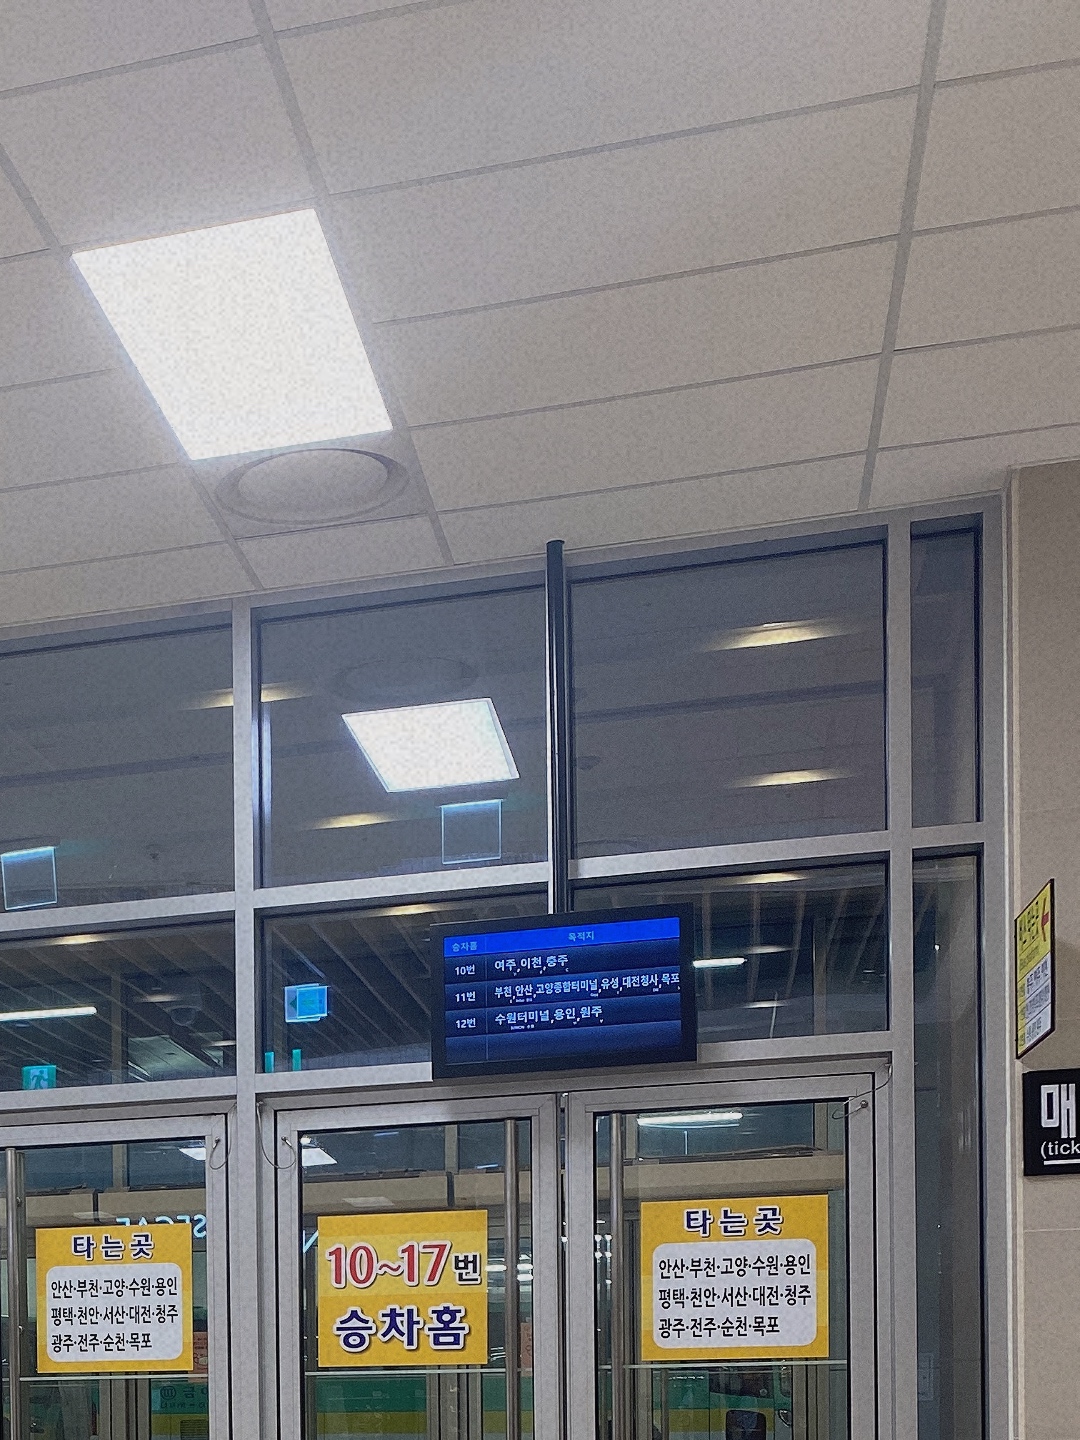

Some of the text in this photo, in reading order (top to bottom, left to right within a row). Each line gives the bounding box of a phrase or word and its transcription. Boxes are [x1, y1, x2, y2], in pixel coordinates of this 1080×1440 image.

[568, 930, 595, 942] 목적지
[454, 964, 476, 976] 10번
[455, 991, 476, 1002] 11번
[456, 1017, 476, 1029] 12번
[1041, 1083, 1076, 1138] 매
[326, 1240, 482, 1289] 10~17번
[333, 1303, 469, 1352] 승차홈
